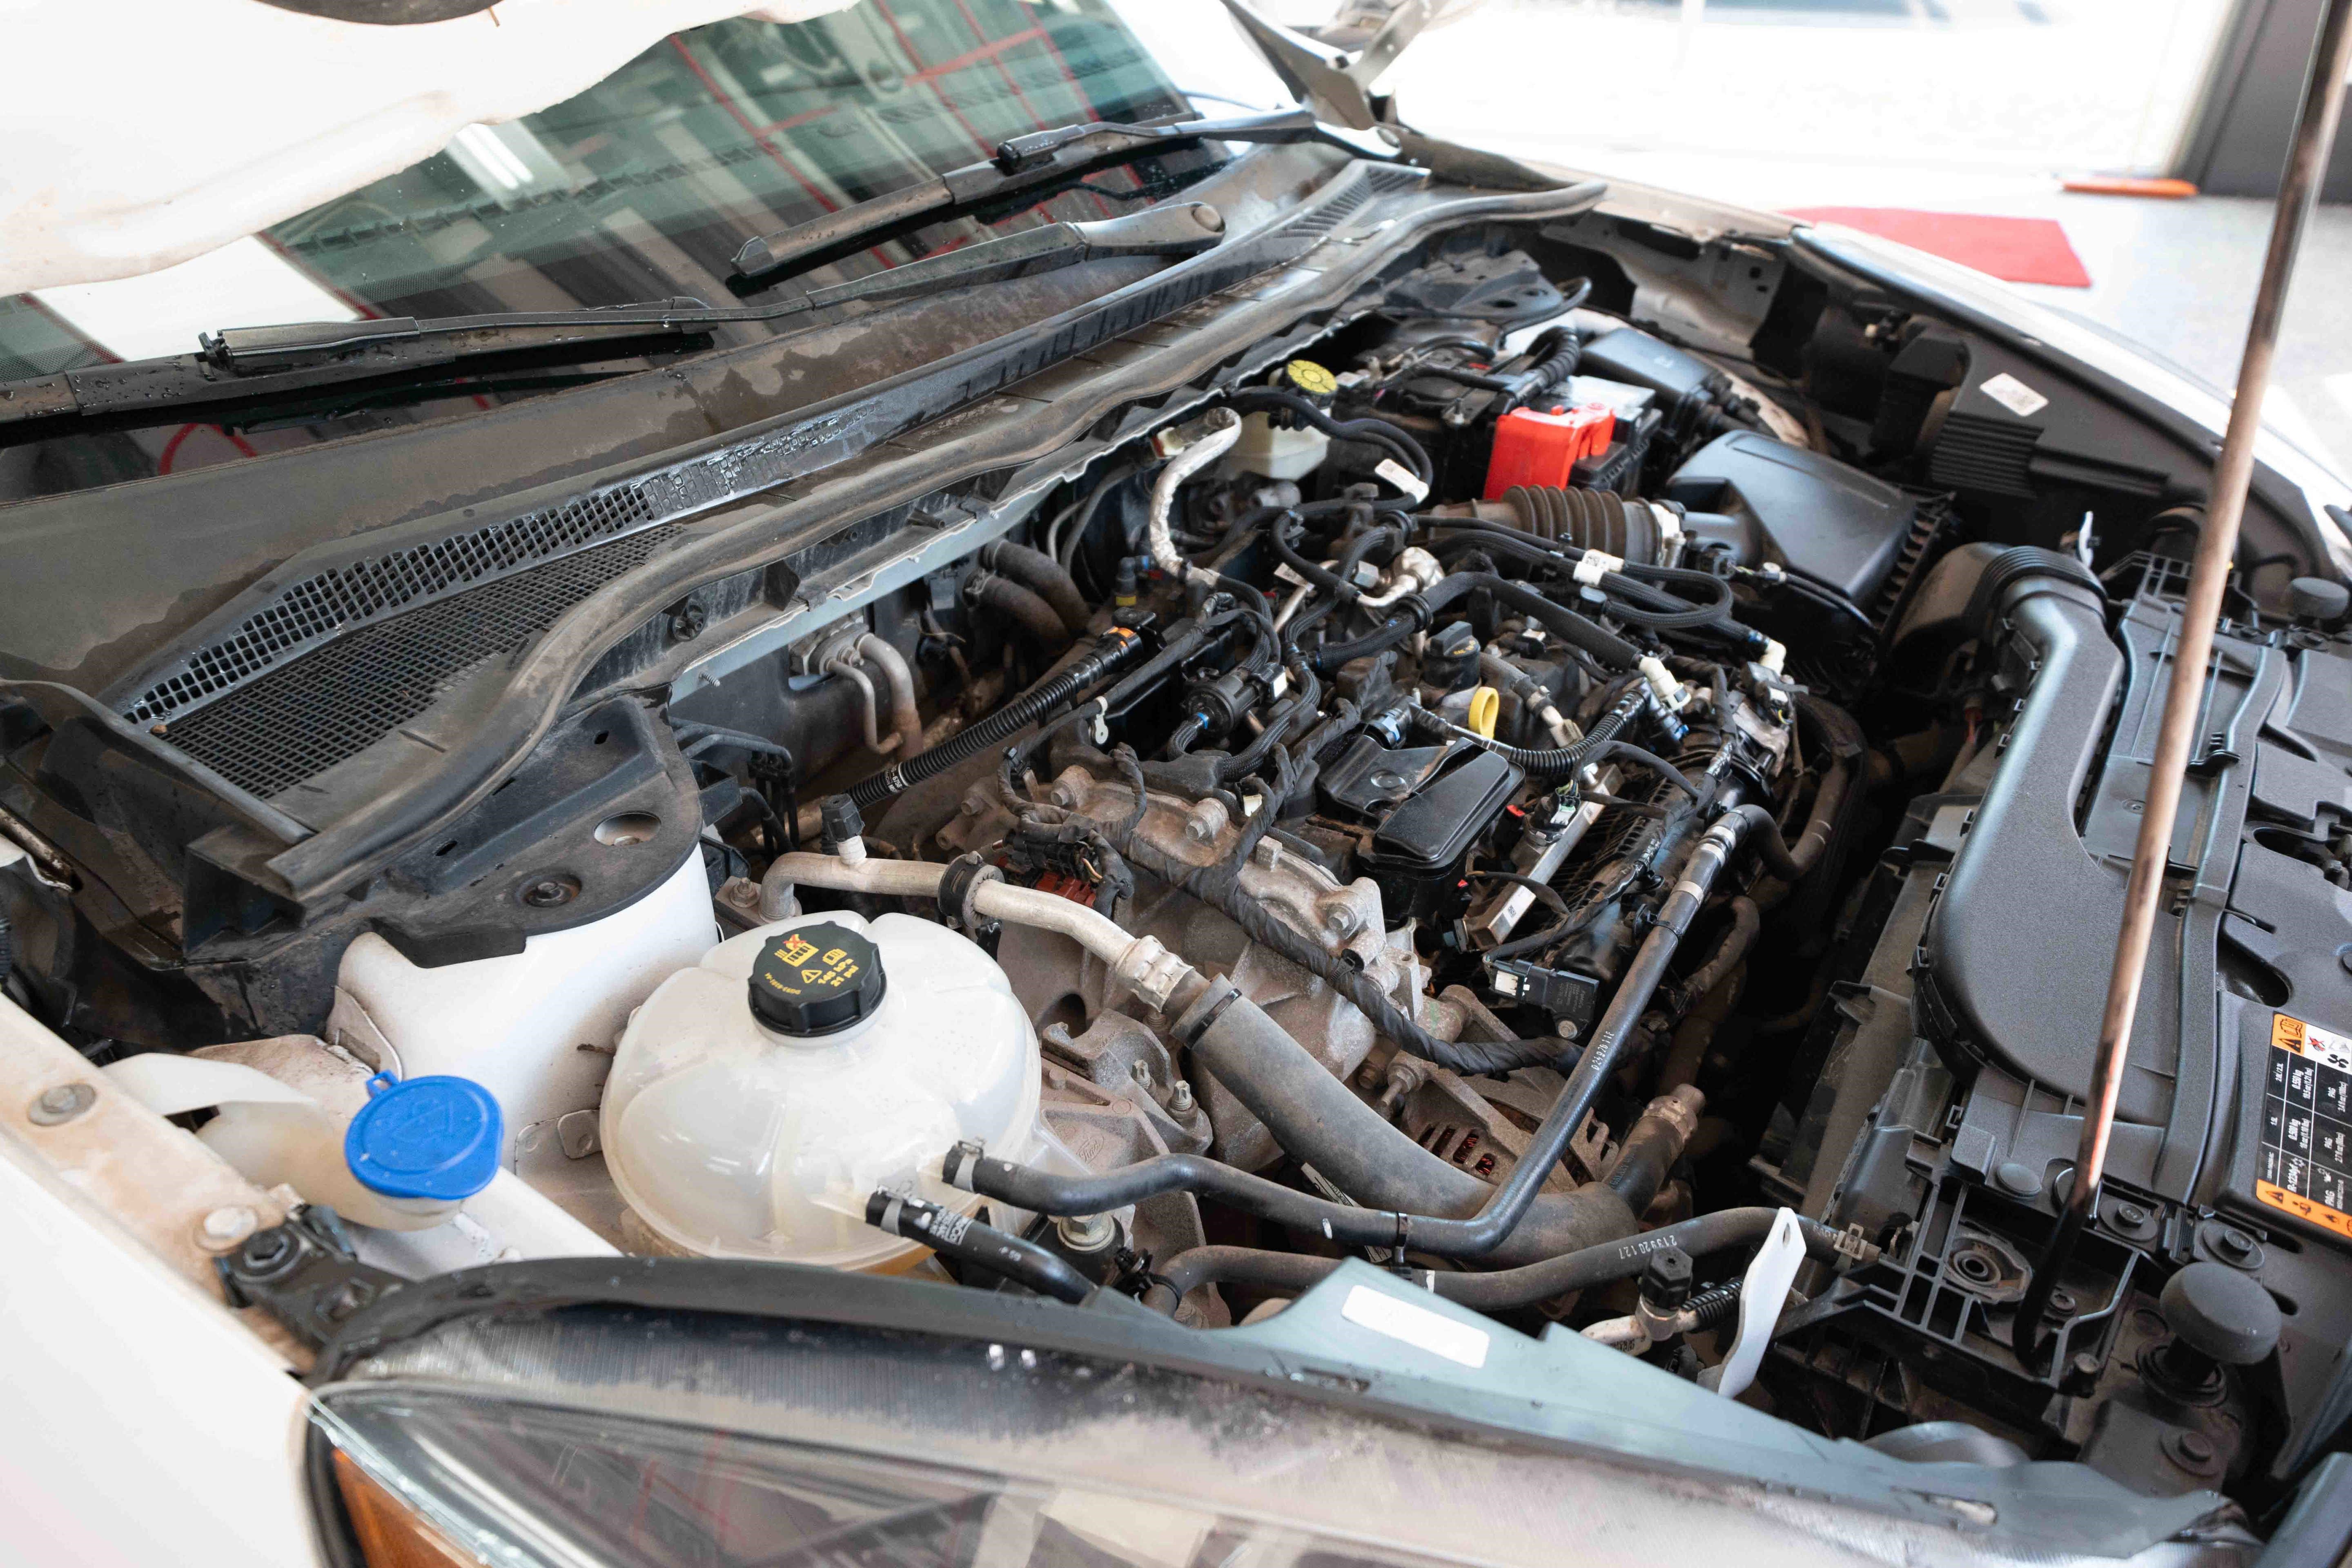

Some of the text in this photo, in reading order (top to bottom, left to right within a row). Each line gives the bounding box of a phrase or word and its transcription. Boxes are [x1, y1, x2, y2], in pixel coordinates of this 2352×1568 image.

[2328, 1087, 2336, 1098] PAG
[2324, 1137, 2332, 1149] PAG
[2287, 1163, 2300, 1192] R-1234yf
[2325, 1190, 2335, 1206] PAG
